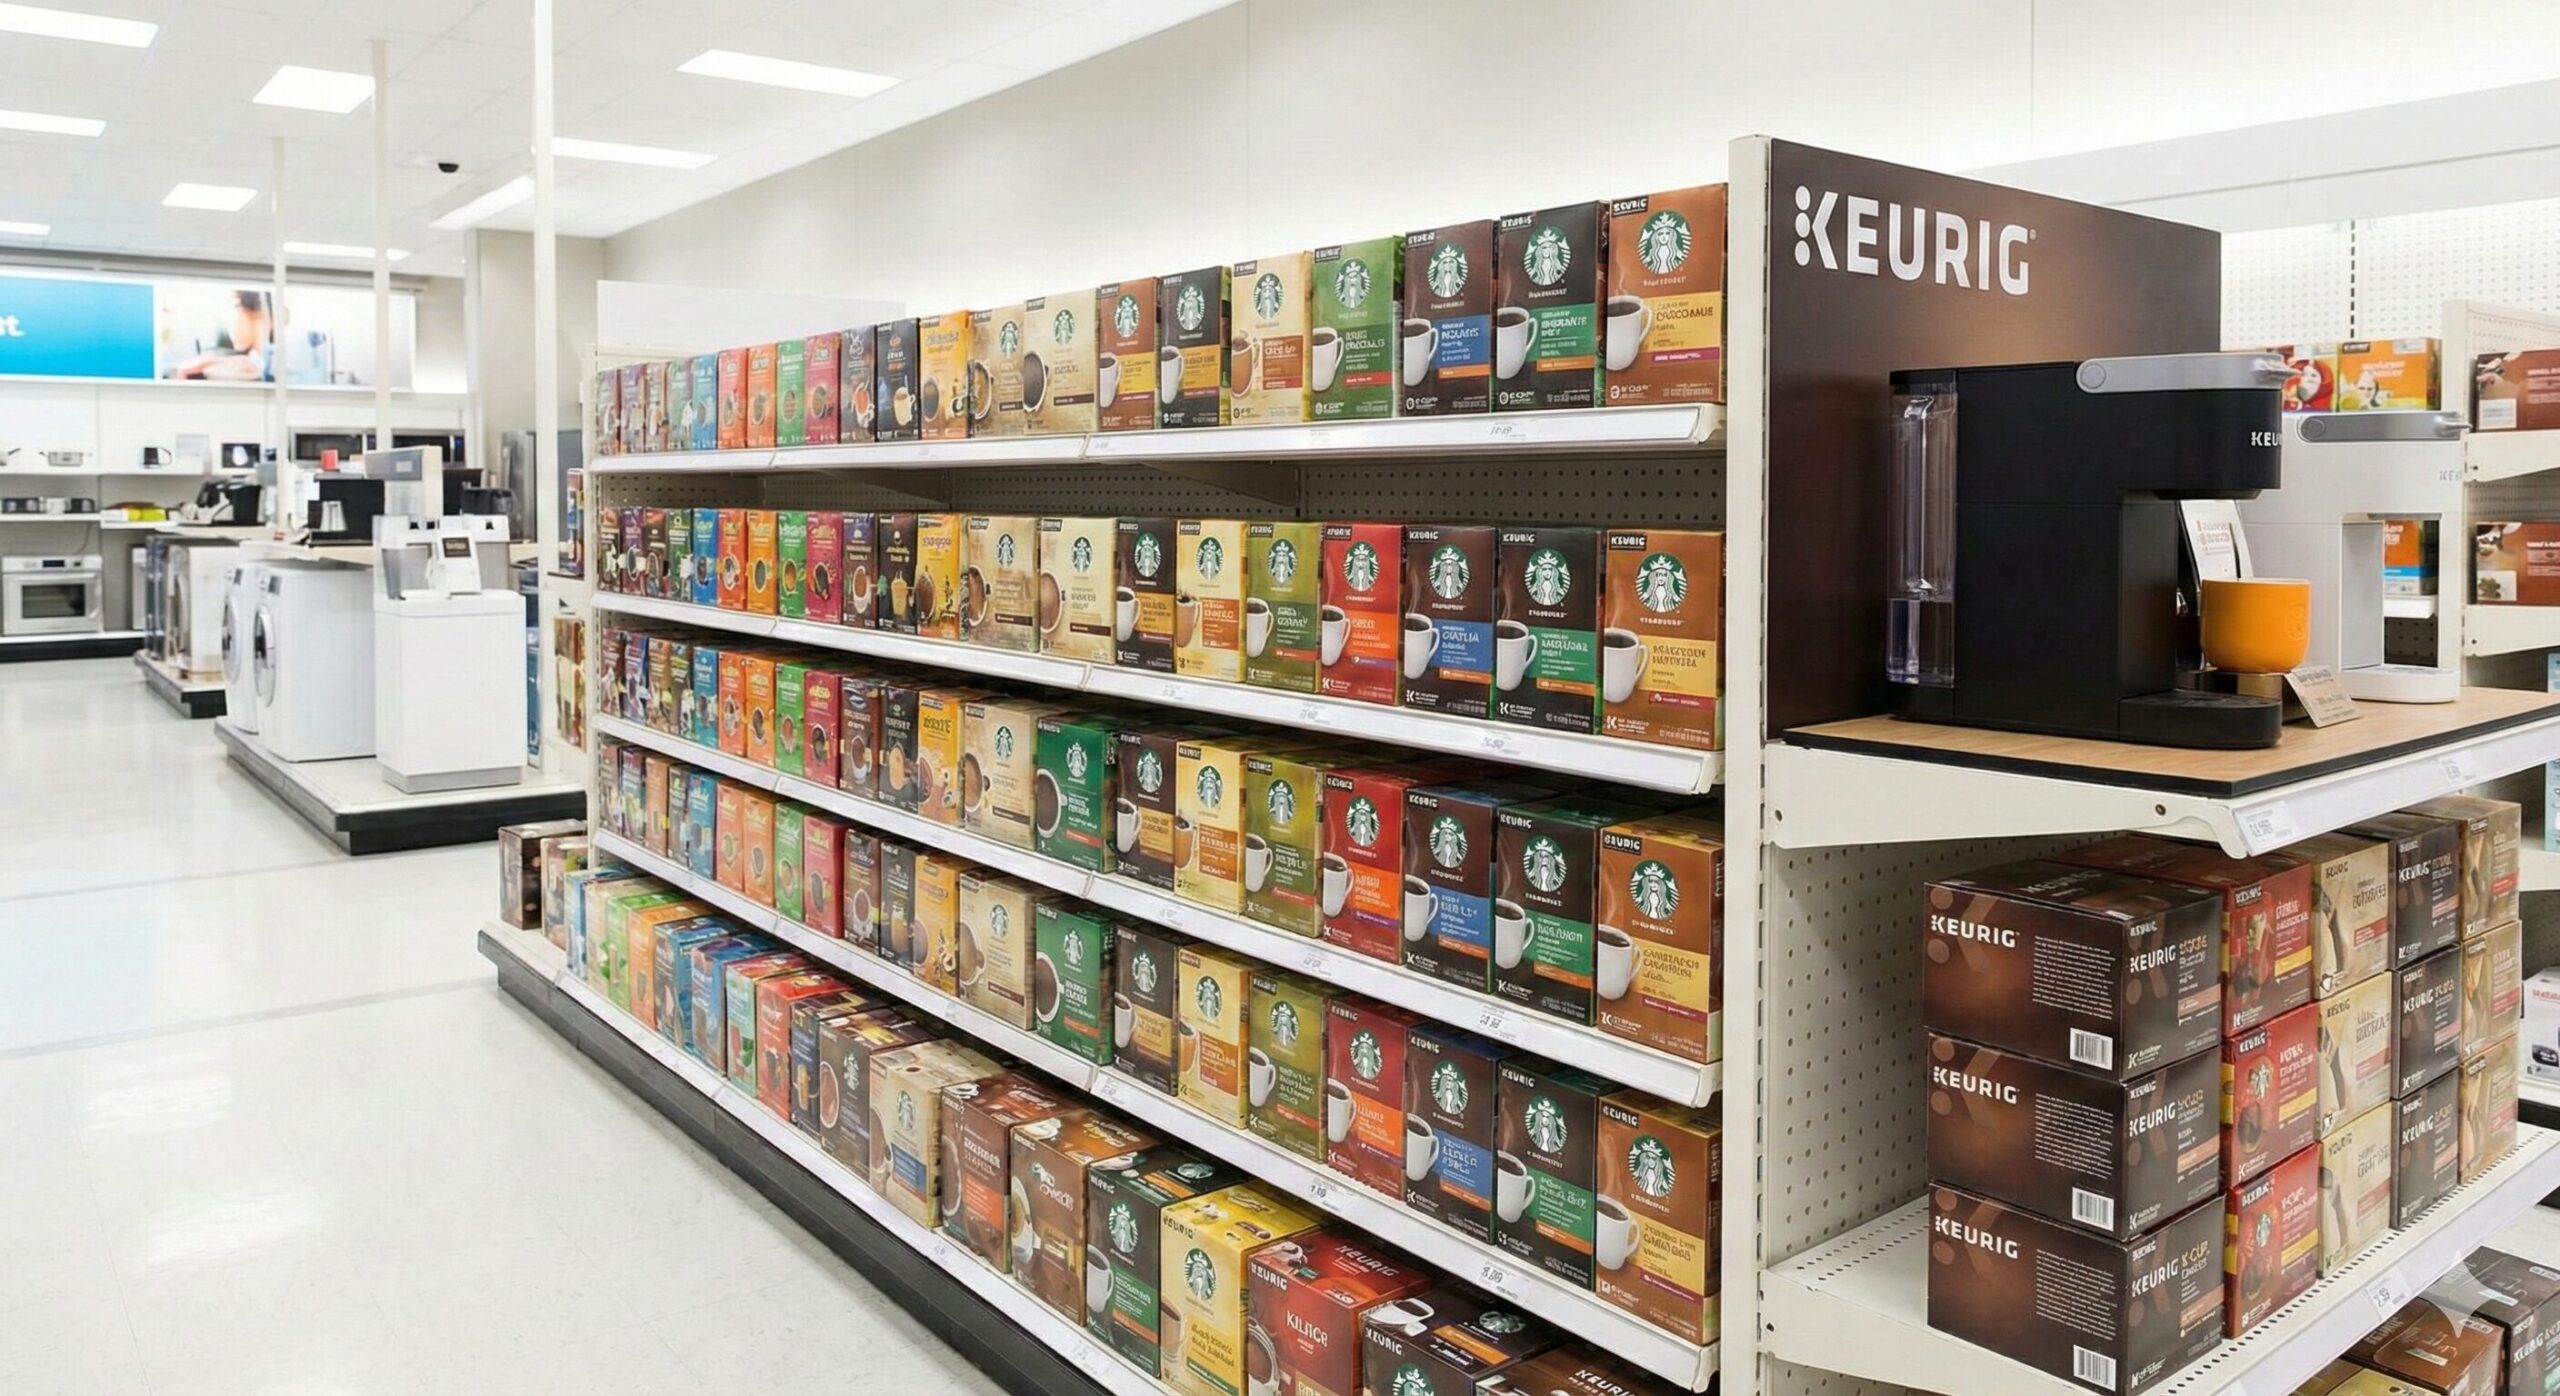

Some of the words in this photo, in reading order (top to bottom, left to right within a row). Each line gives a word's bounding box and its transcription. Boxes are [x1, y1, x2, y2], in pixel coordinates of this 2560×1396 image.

[1795, 184, 2029, 296] KEURIG
[1931, 914, 2016, 948] KEURIG
[2130, 945, 2177, 973] KEURIG
[1933, 1066, 2018, 1105] KEURIG
[2129, 1101, 2176, 1137] KEURIG
[1935, 1215, 2019, 1260] KEURIG
[1251, 1261, 1288, 1291] KEURIG
[1335, 1245, 1399, 1277] KEURIG
[2131, 1258, 2179, 1298] KEURIG
